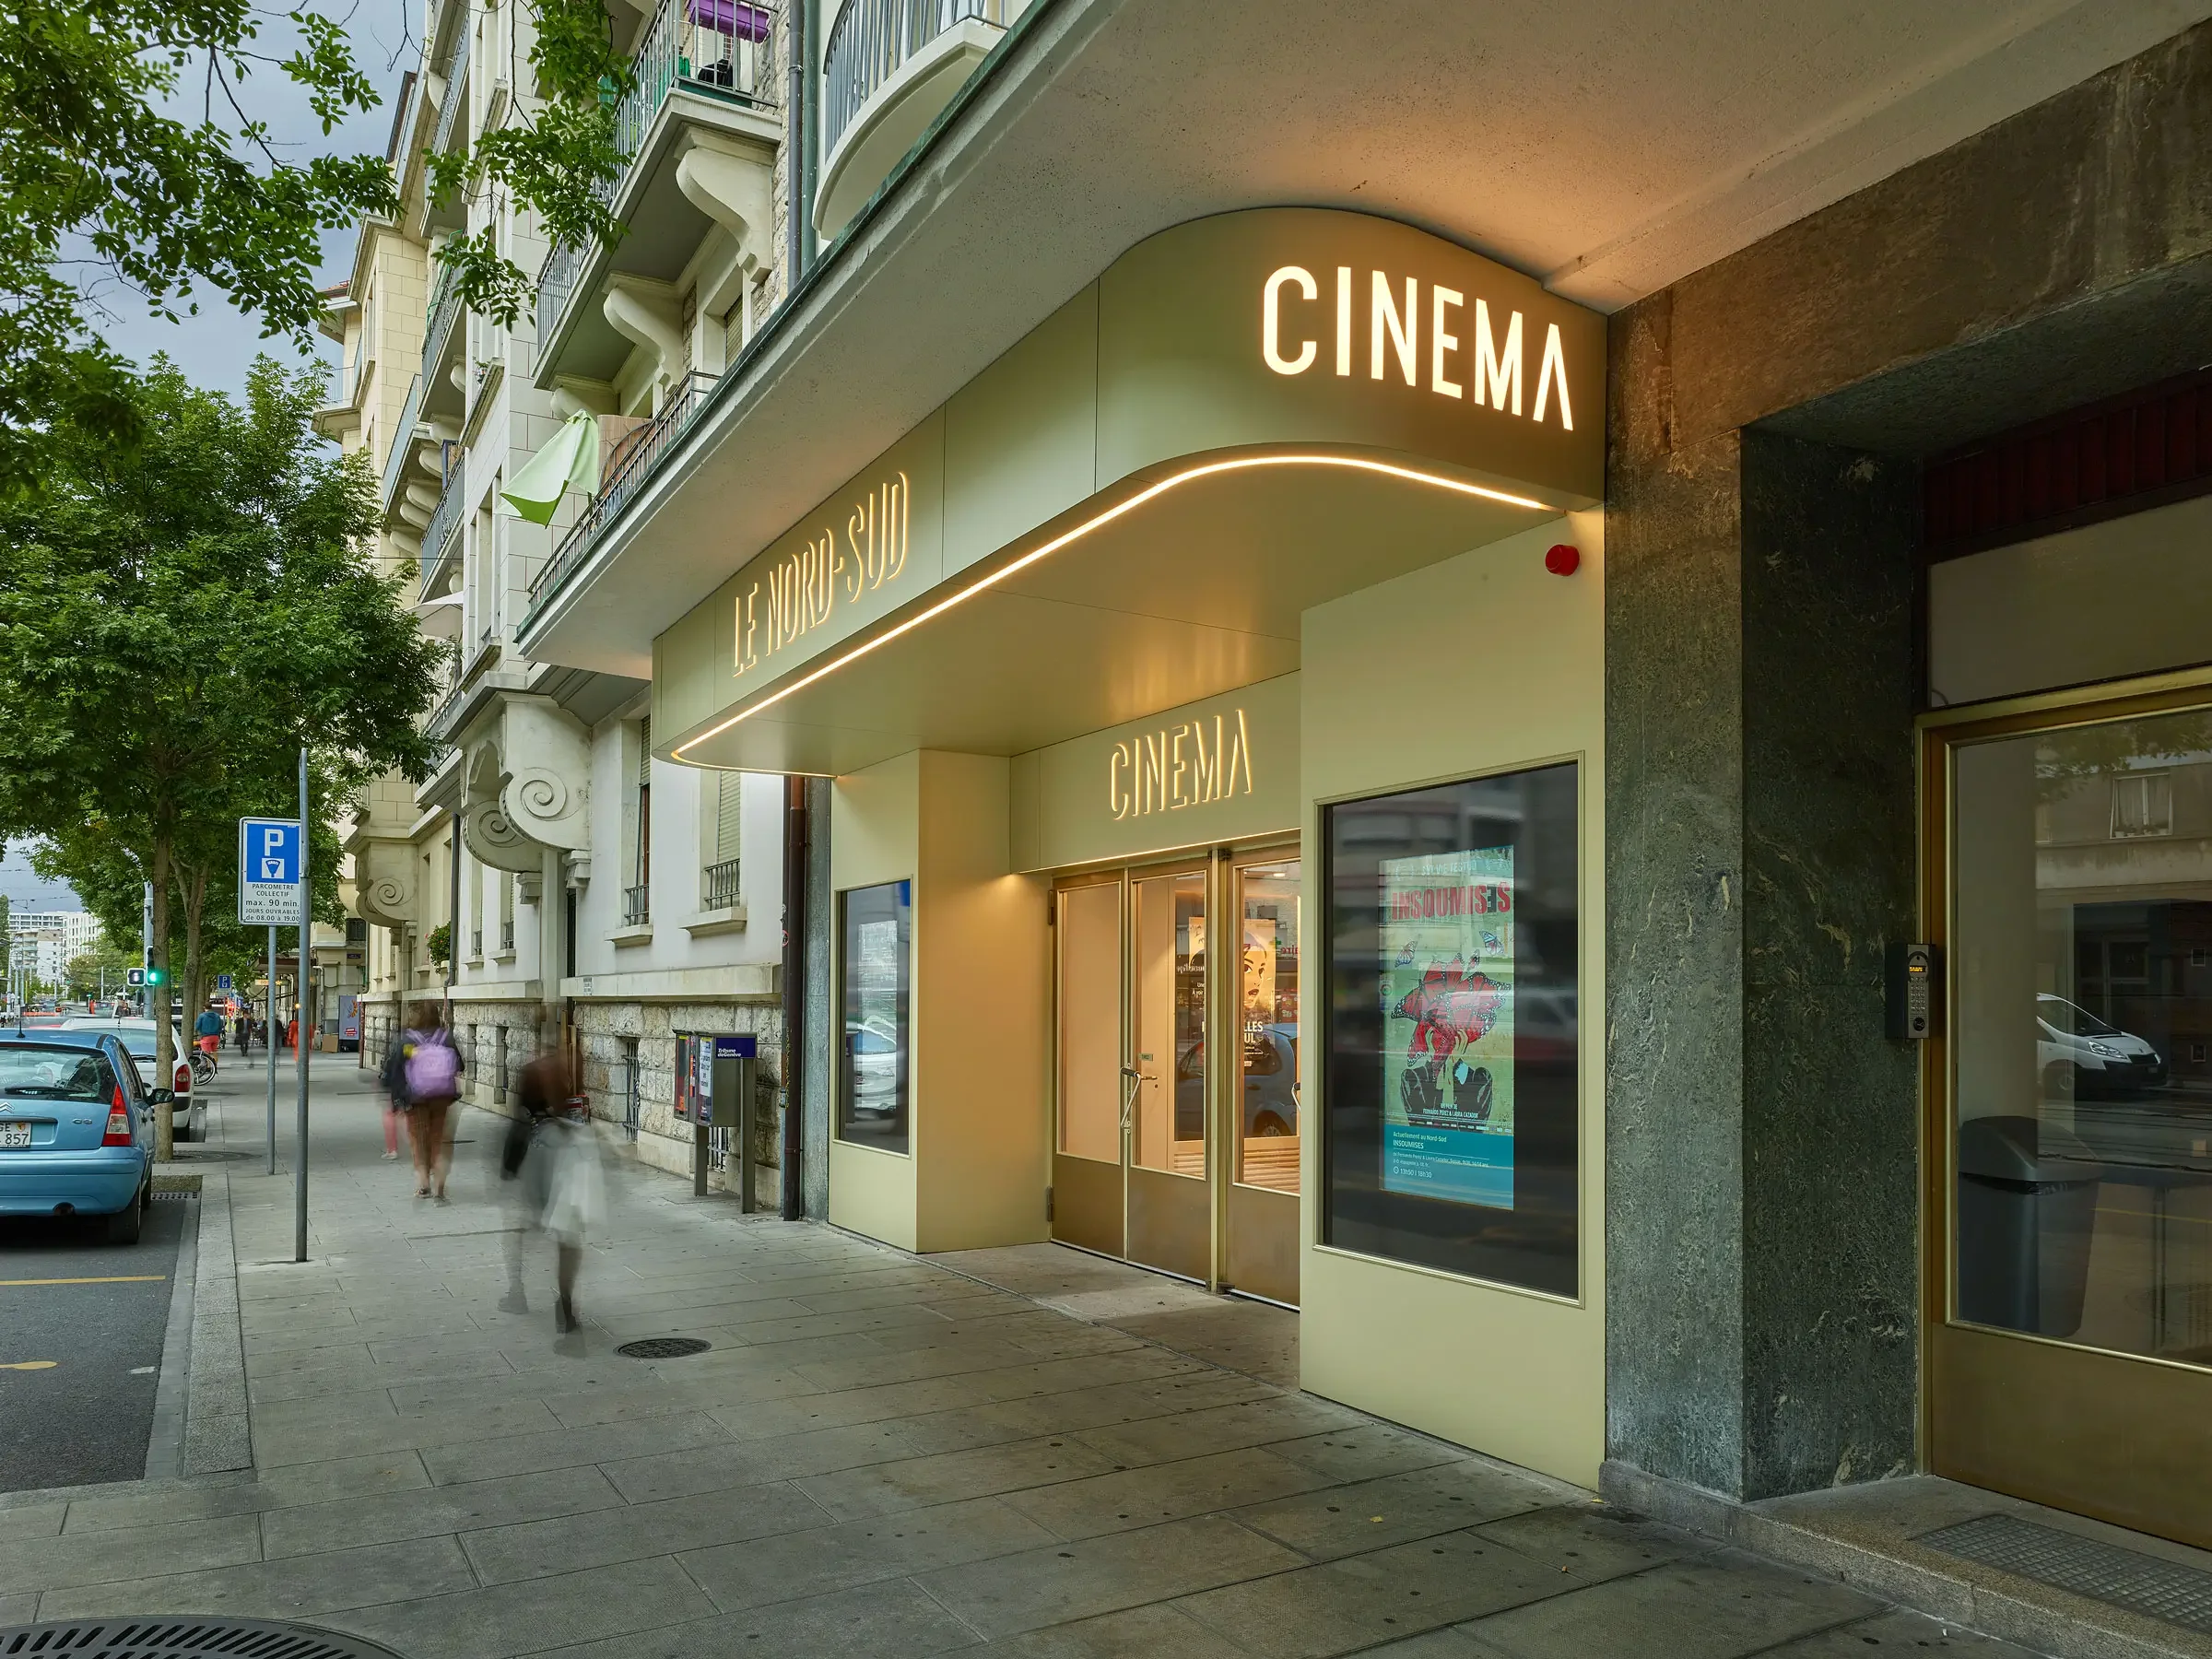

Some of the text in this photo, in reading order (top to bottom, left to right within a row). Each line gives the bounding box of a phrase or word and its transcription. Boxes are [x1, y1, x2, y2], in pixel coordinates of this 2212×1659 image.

[1263, 265, 1573, 431] CINEMA
[733, 471, 910, 678] LE NORD-SUD
[1111, 709, 1253, 820] CINEMA
[265, 829, 284, 856] P
[1391, 882, 1512, 921] INSOUMISES
[1393, 1140, 1424, 1149] INSOUMISES
[1400, 1168, 1414, 1176] 13h50
